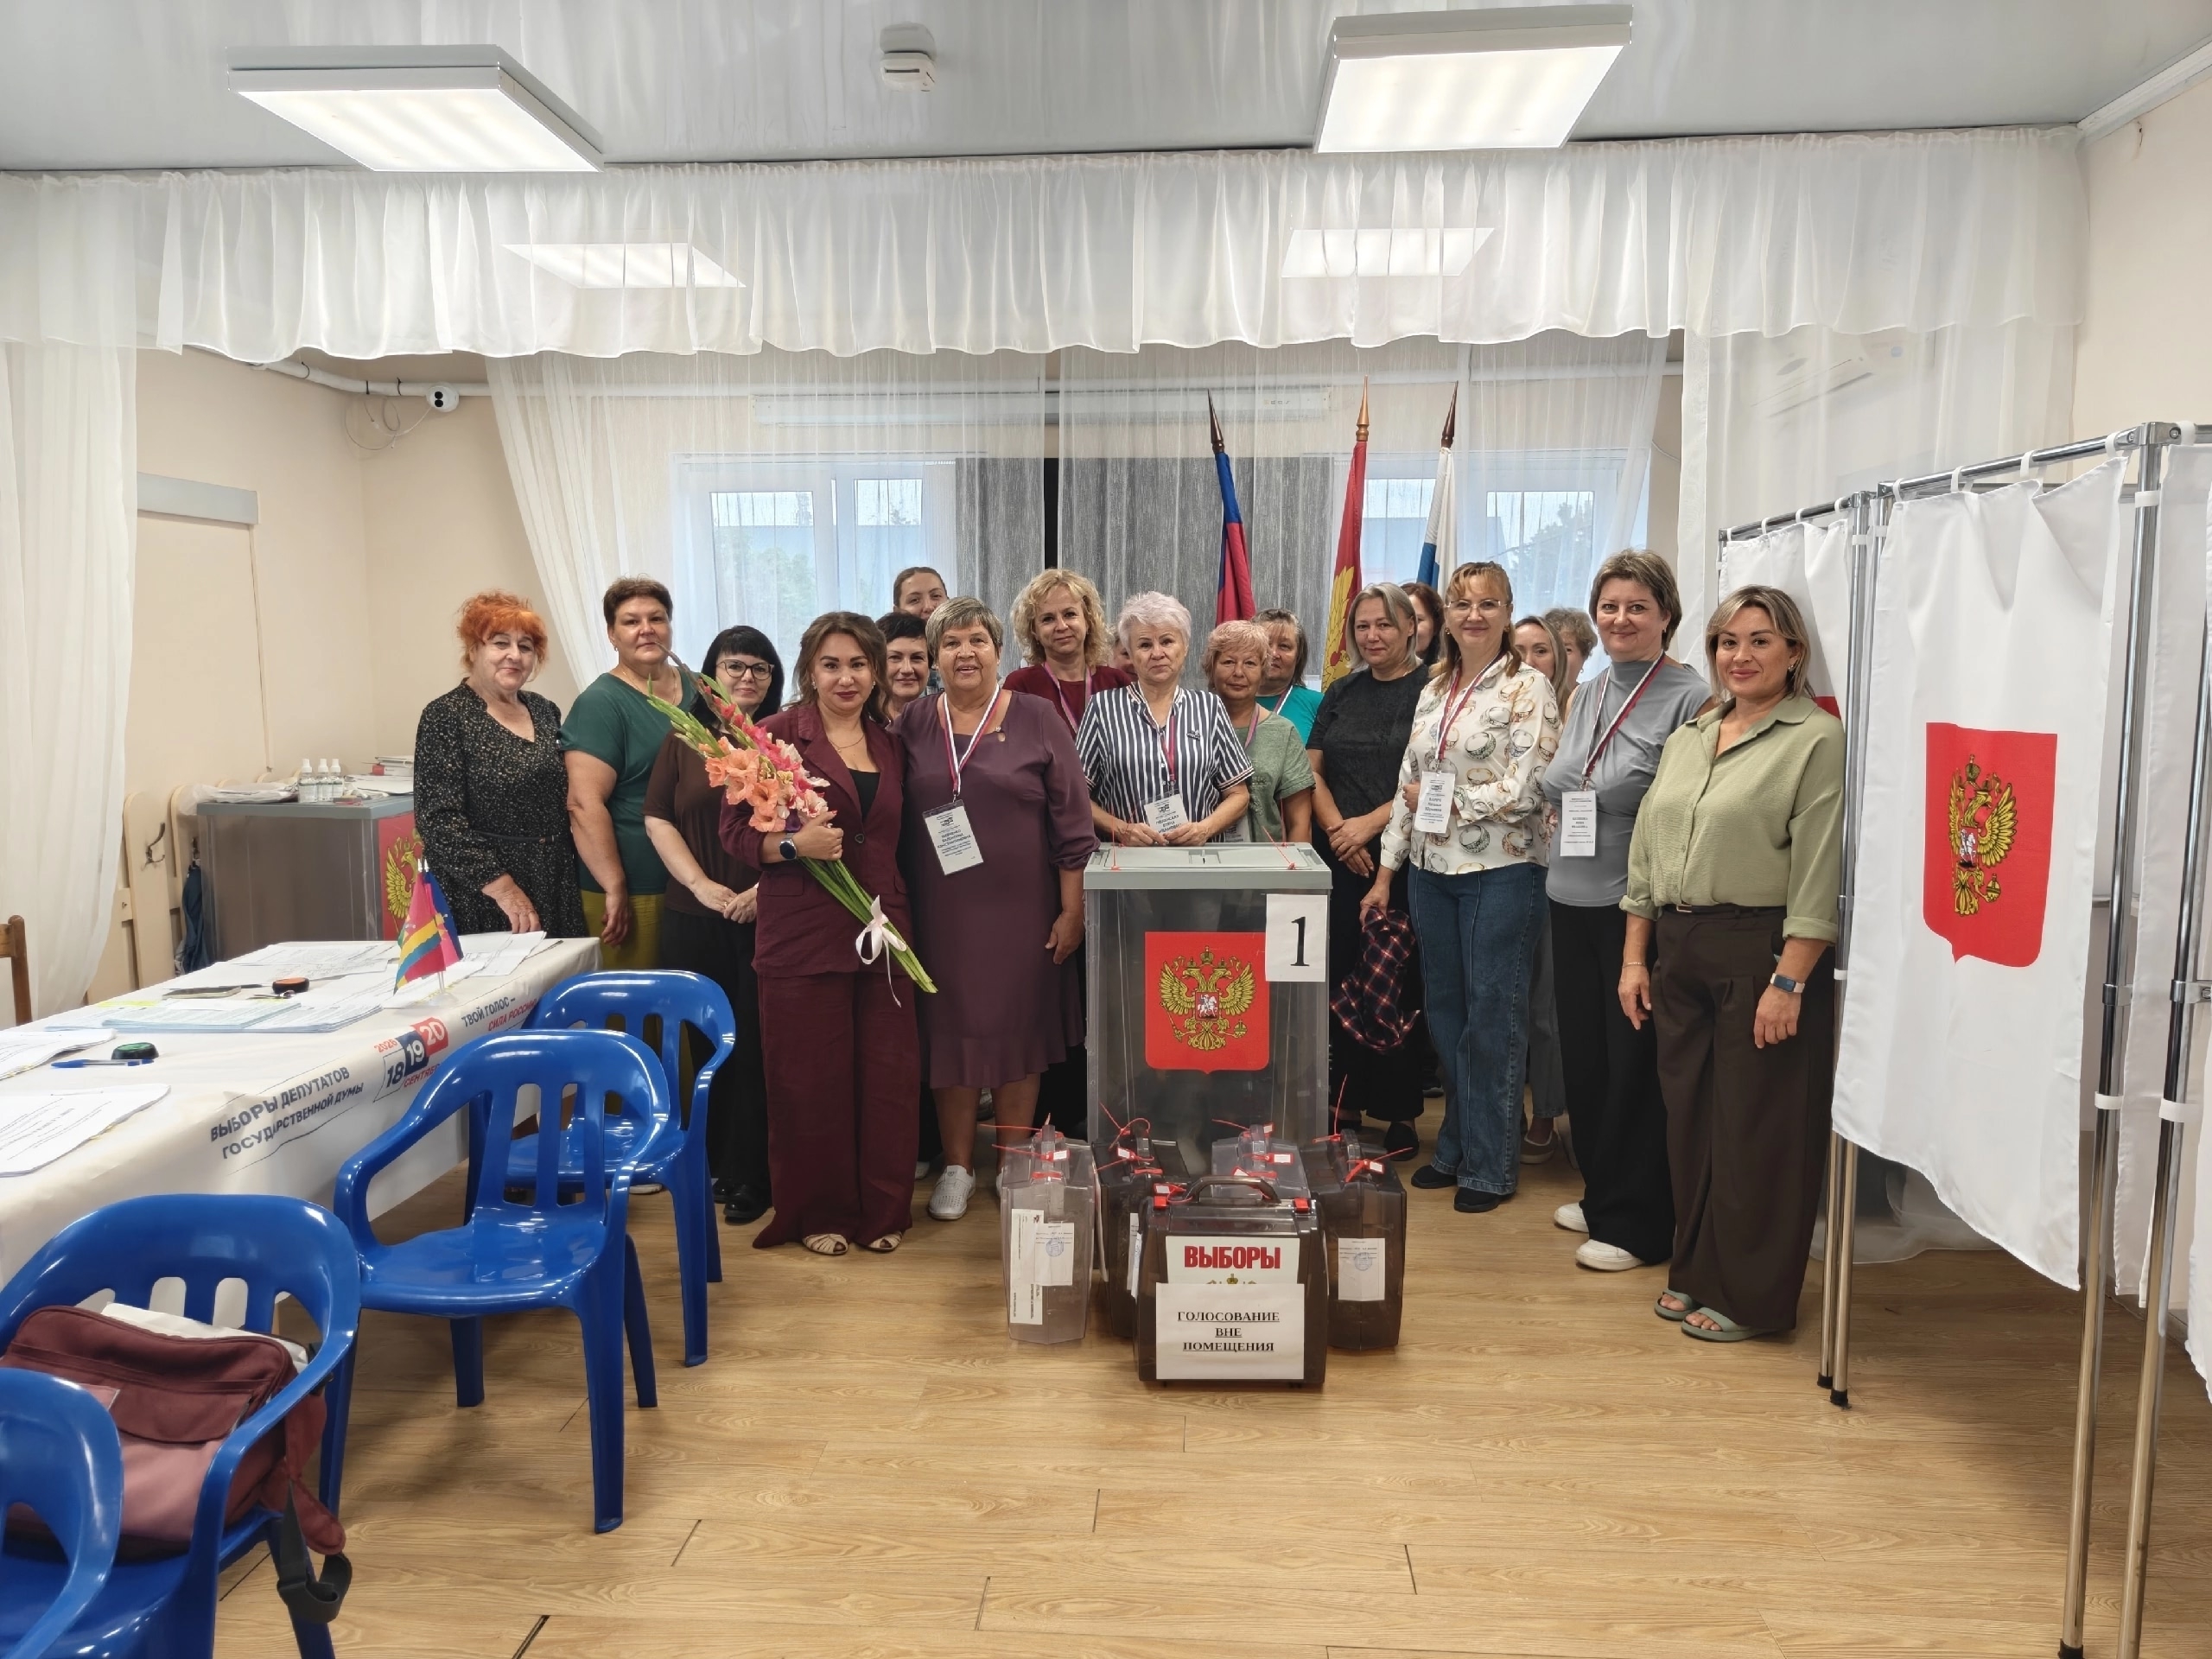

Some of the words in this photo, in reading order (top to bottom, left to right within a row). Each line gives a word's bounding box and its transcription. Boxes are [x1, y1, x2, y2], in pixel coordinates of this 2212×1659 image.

[1290, 917, 1310, 966] 1
[461, 1007, 485, 1027] ТВОЙ
[485, 996, 510, 1017] ГОЛОС
[488, 1014, 507, 1032] СИЛА
[373, 1039, 398, 1053] 2026
[420, 1021, 446, 1046] 20
[405, 1039, 425, 1066] 19
[386, 1062, 405, 1088] 18
[210, 1096, 278, 1142] ВЫБОРЫ
[281, 1066, 350, 1109] ДЕПУТАТОВ
[222, 1093, 334, 1159] ГОСУДАРСТВЕННОЙ
[334, 1082, 365, 1105] ДУМЫ
[1184, 1245, 1281, 1269] ВЫБОРЫ
[1177, 1311, 1280, 1322] ГОЛОСОВАНИЕ
[1215, 1327, 1243, 1338] ВНЕ
[1183, 1342, 1274, 1352] ПОМЕЩЕНИЯ
